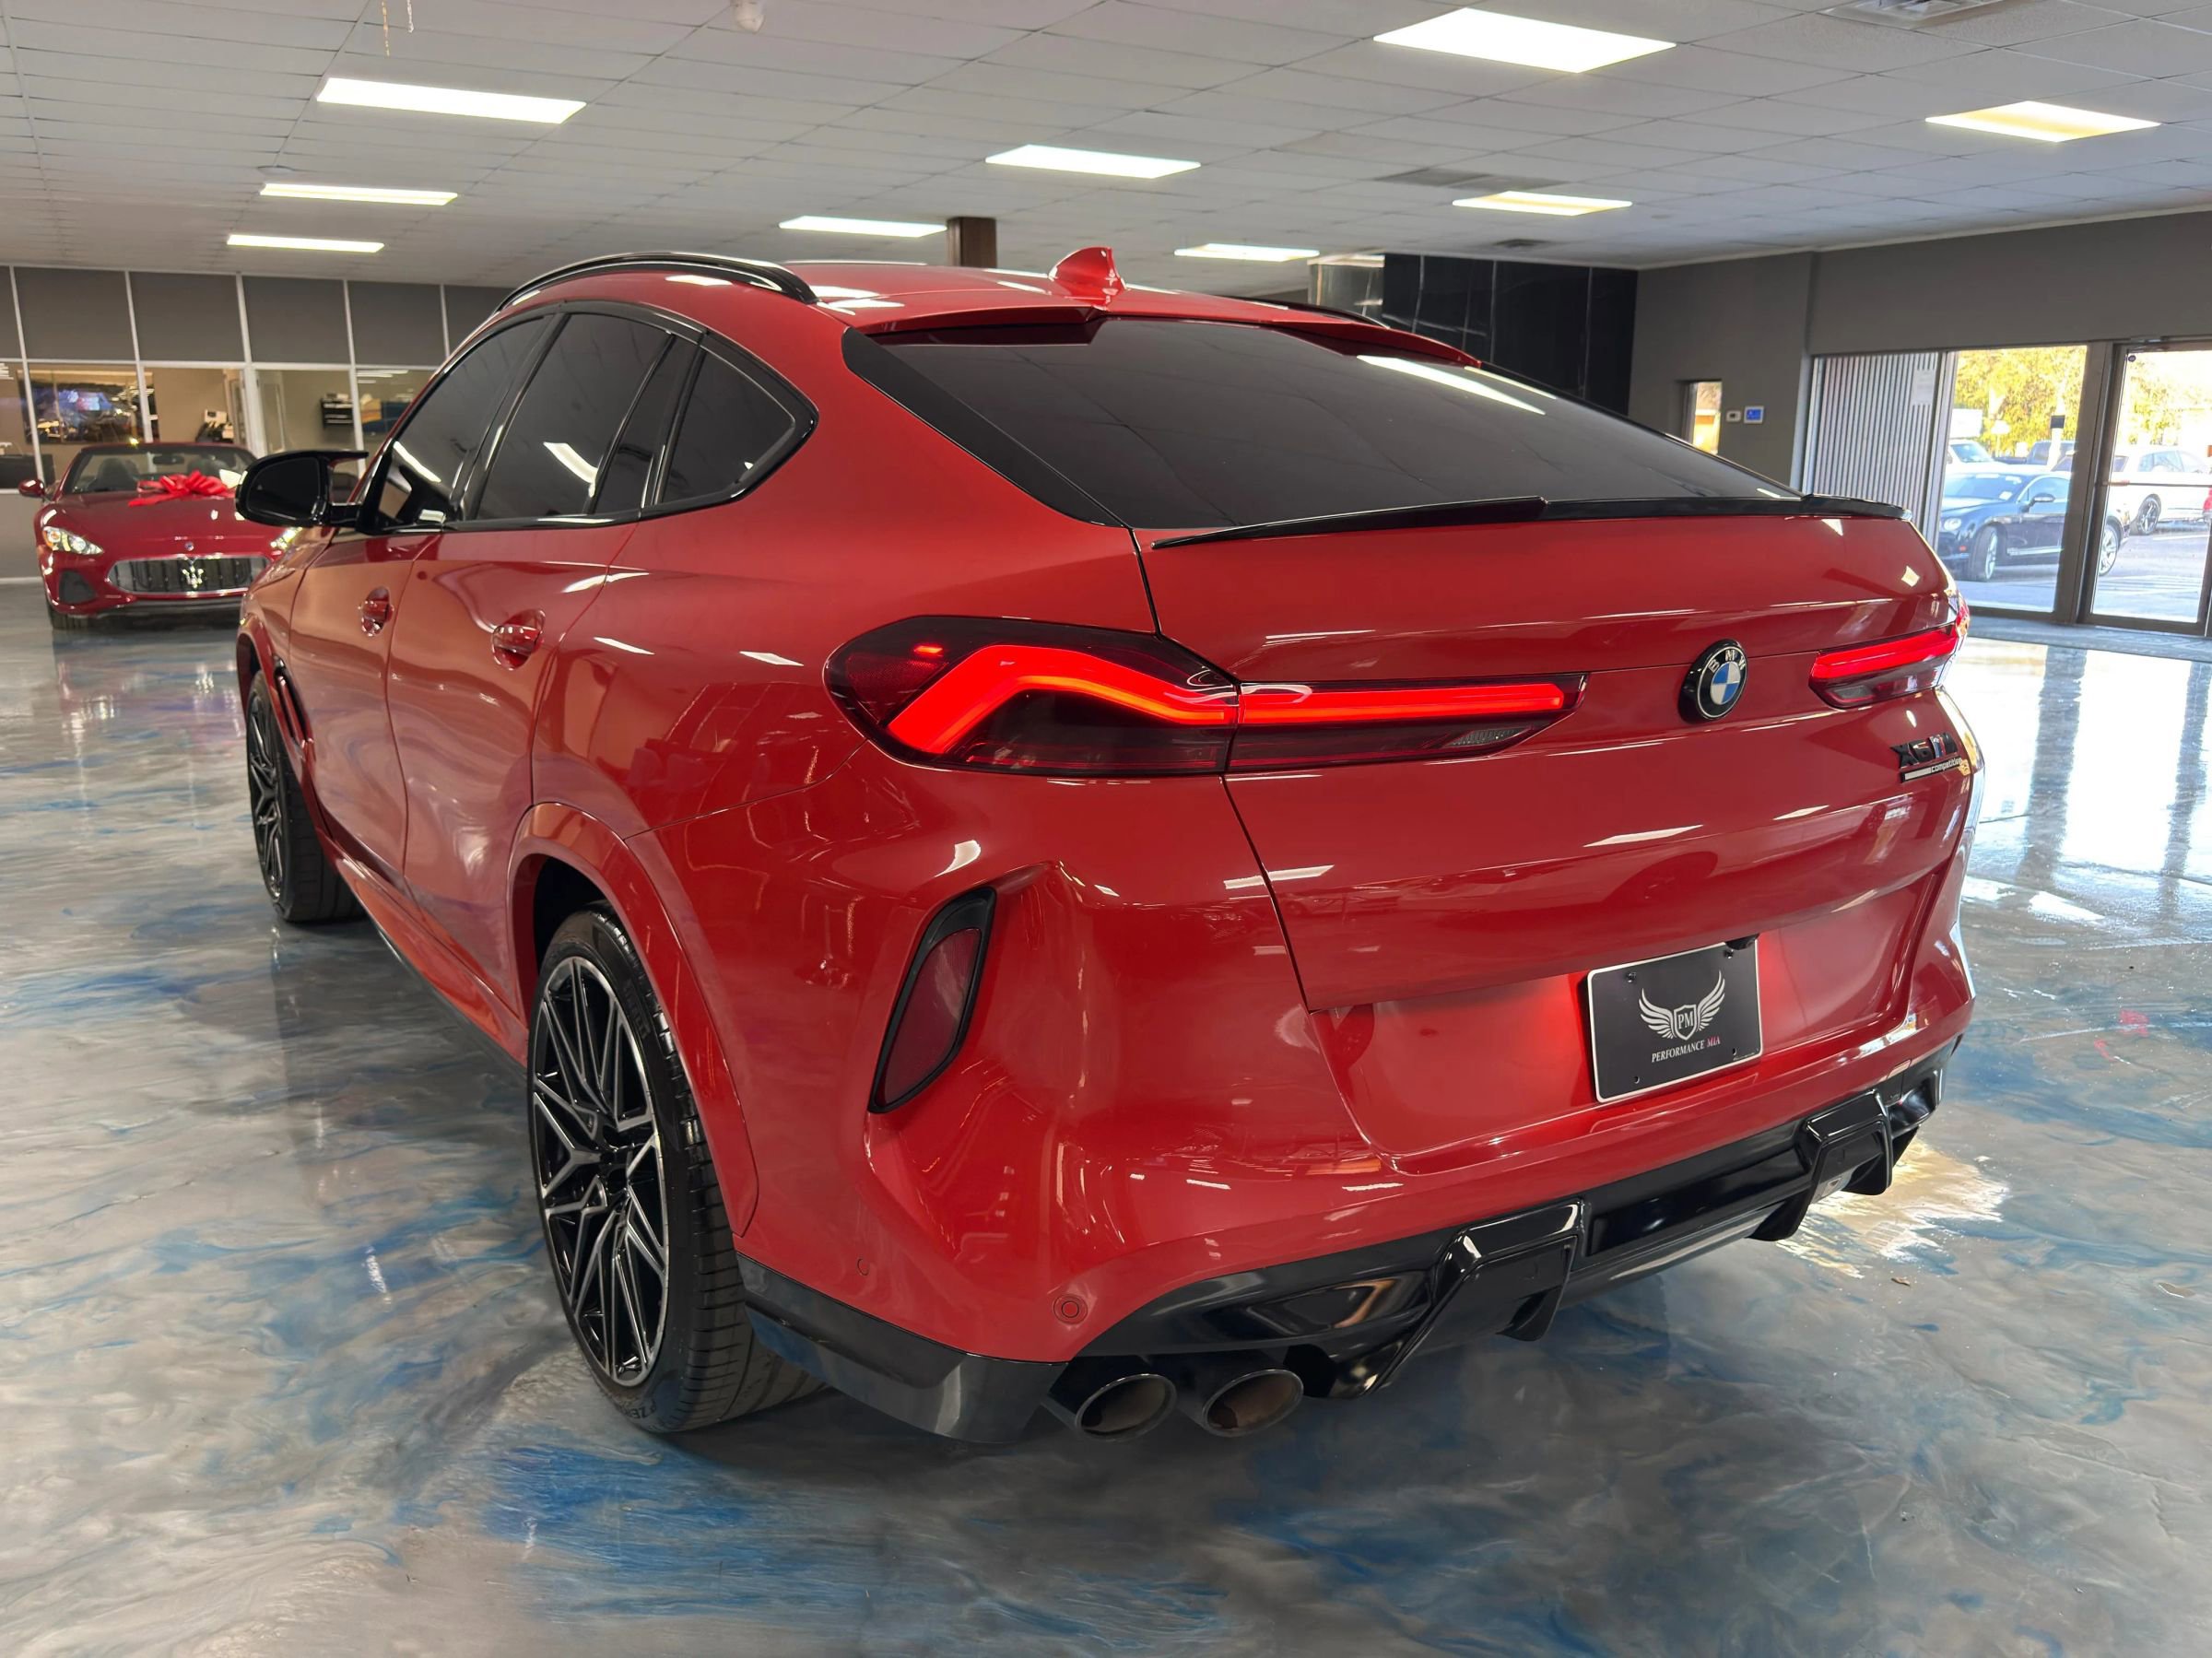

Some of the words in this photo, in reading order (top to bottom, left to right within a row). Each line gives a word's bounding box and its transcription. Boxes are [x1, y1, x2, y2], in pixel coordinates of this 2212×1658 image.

[1708, 649, 1747, 674] BMW
[1677, 1010, 1694, 1029] PM
[1651, 1039, 1705, 1064] PERFORMANCE
[1706, 1035, 1721, 1048] MIA
